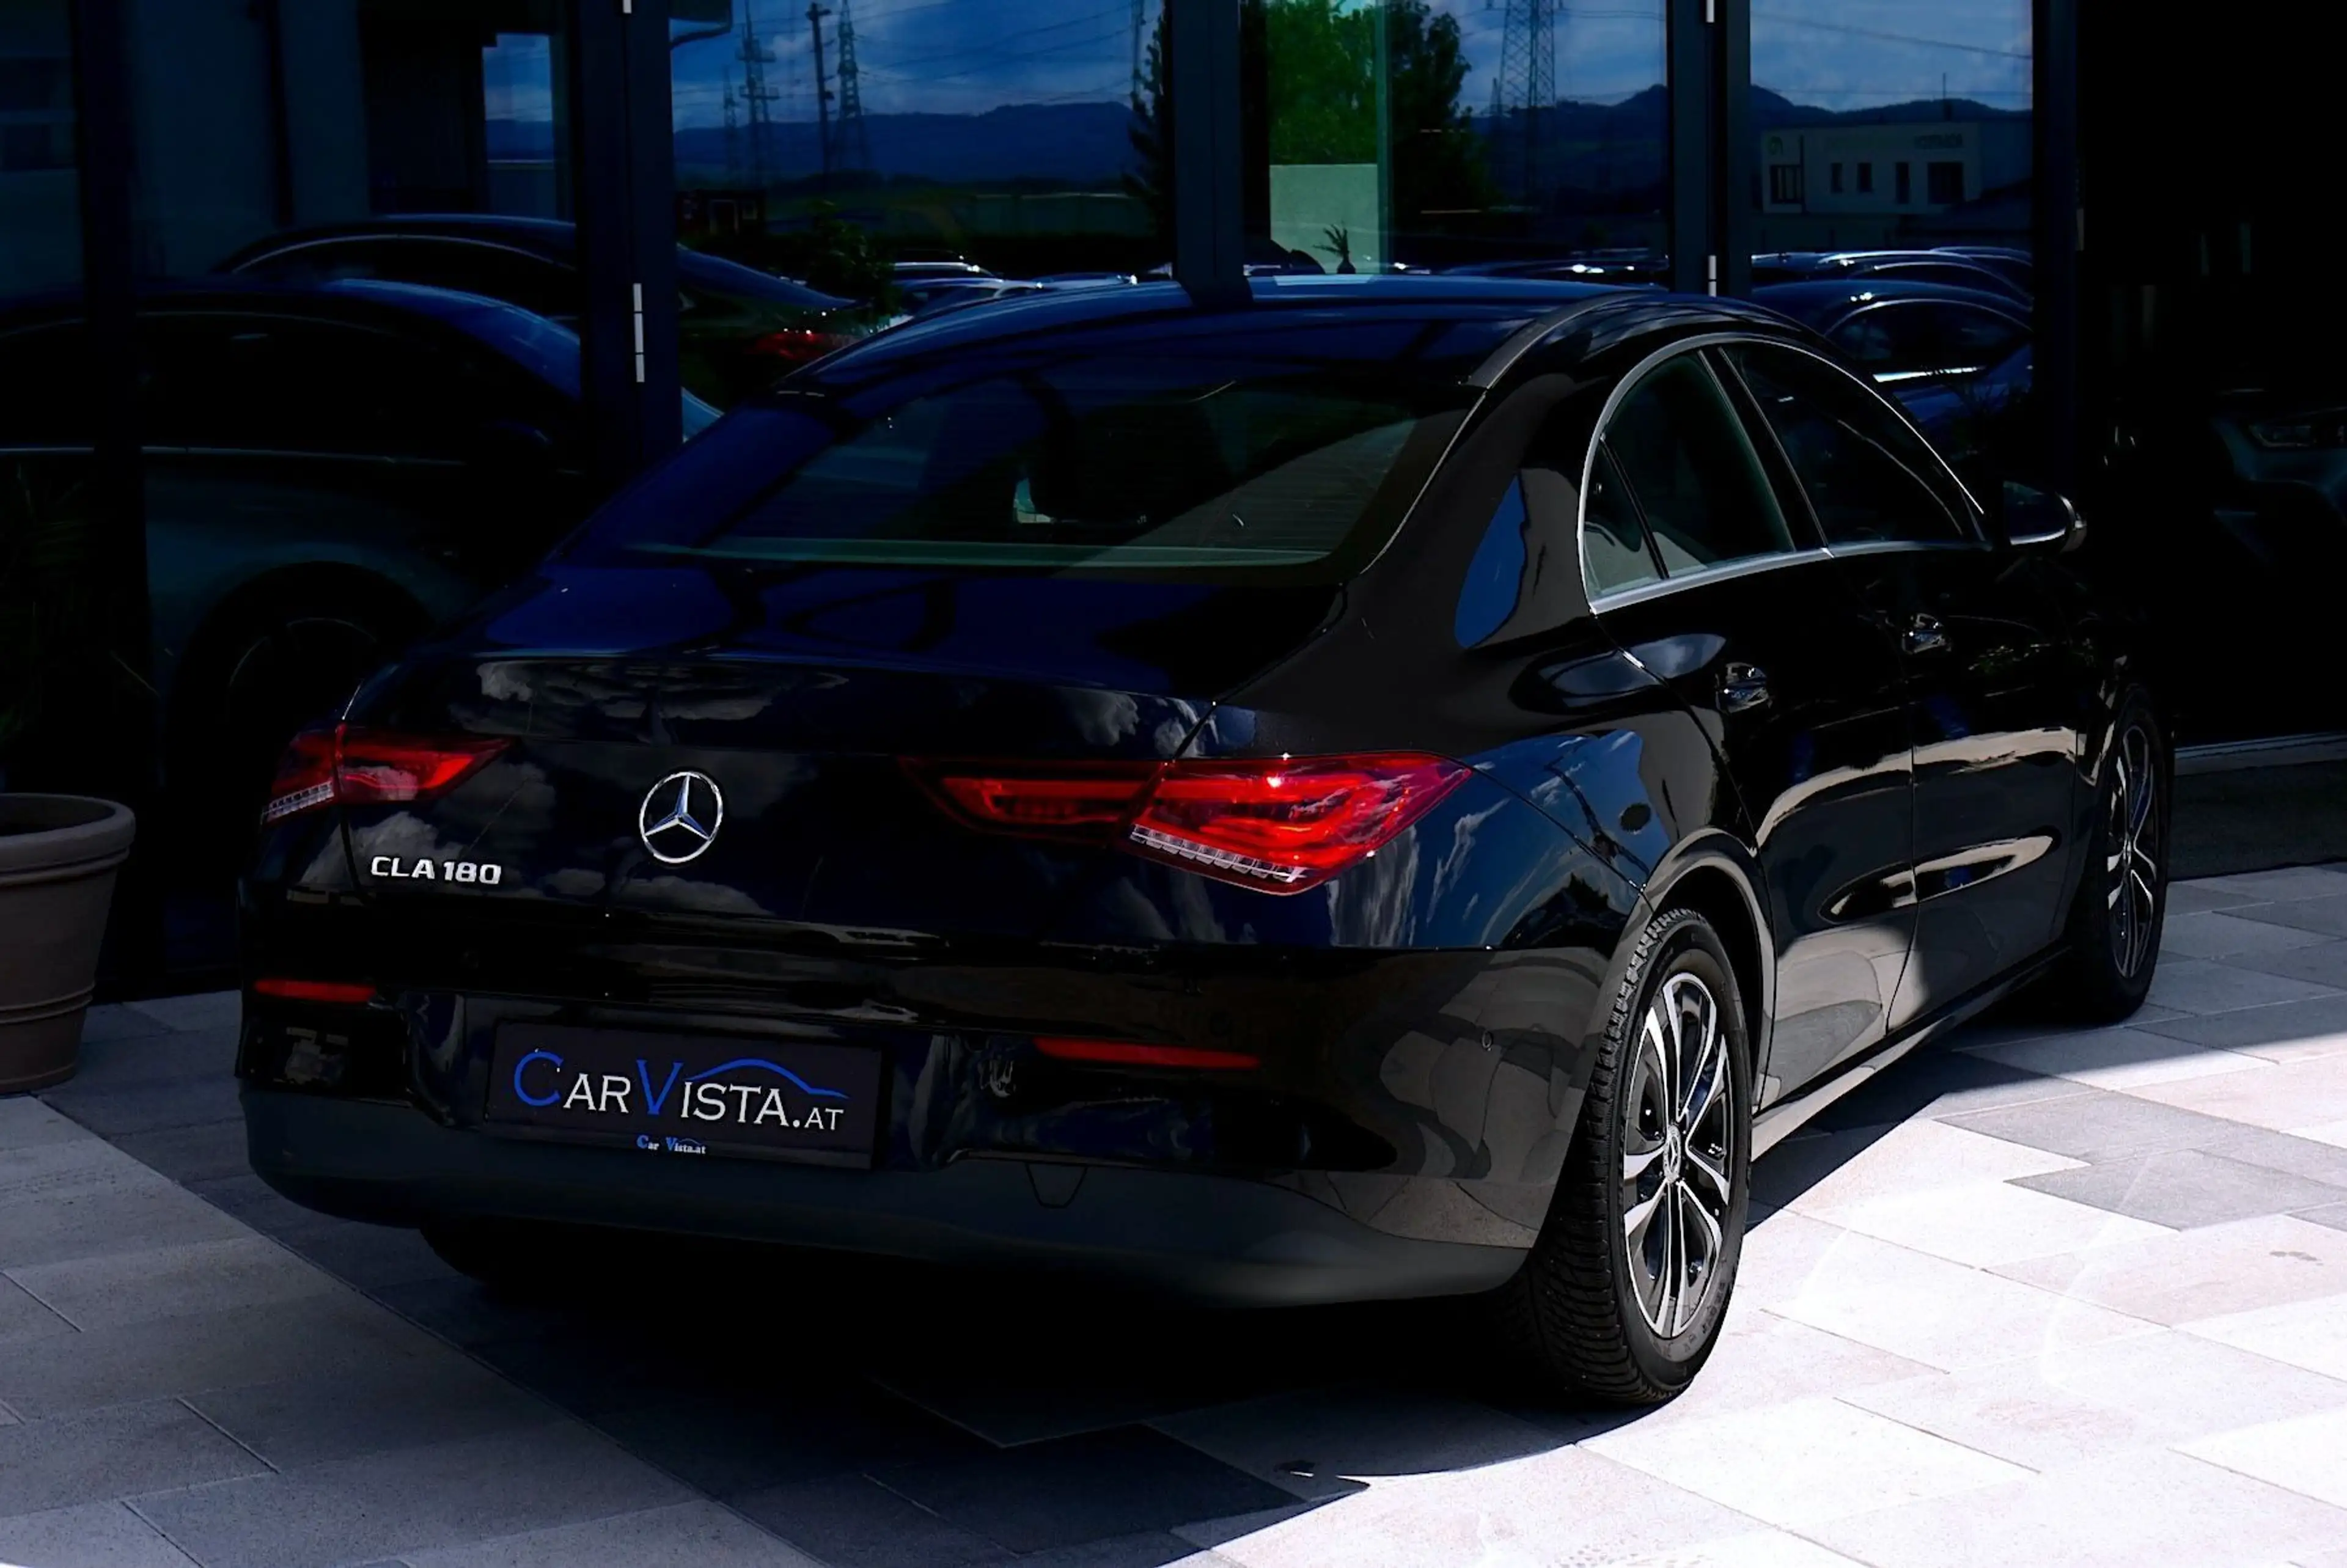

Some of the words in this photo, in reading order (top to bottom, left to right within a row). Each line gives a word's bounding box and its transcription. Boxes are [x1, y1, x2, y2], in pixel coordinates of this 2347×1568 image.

[370, 856, 436, 880] CLA
[443, 862, 501, 884] 180
[636, 1135, 659, 1150] Car
